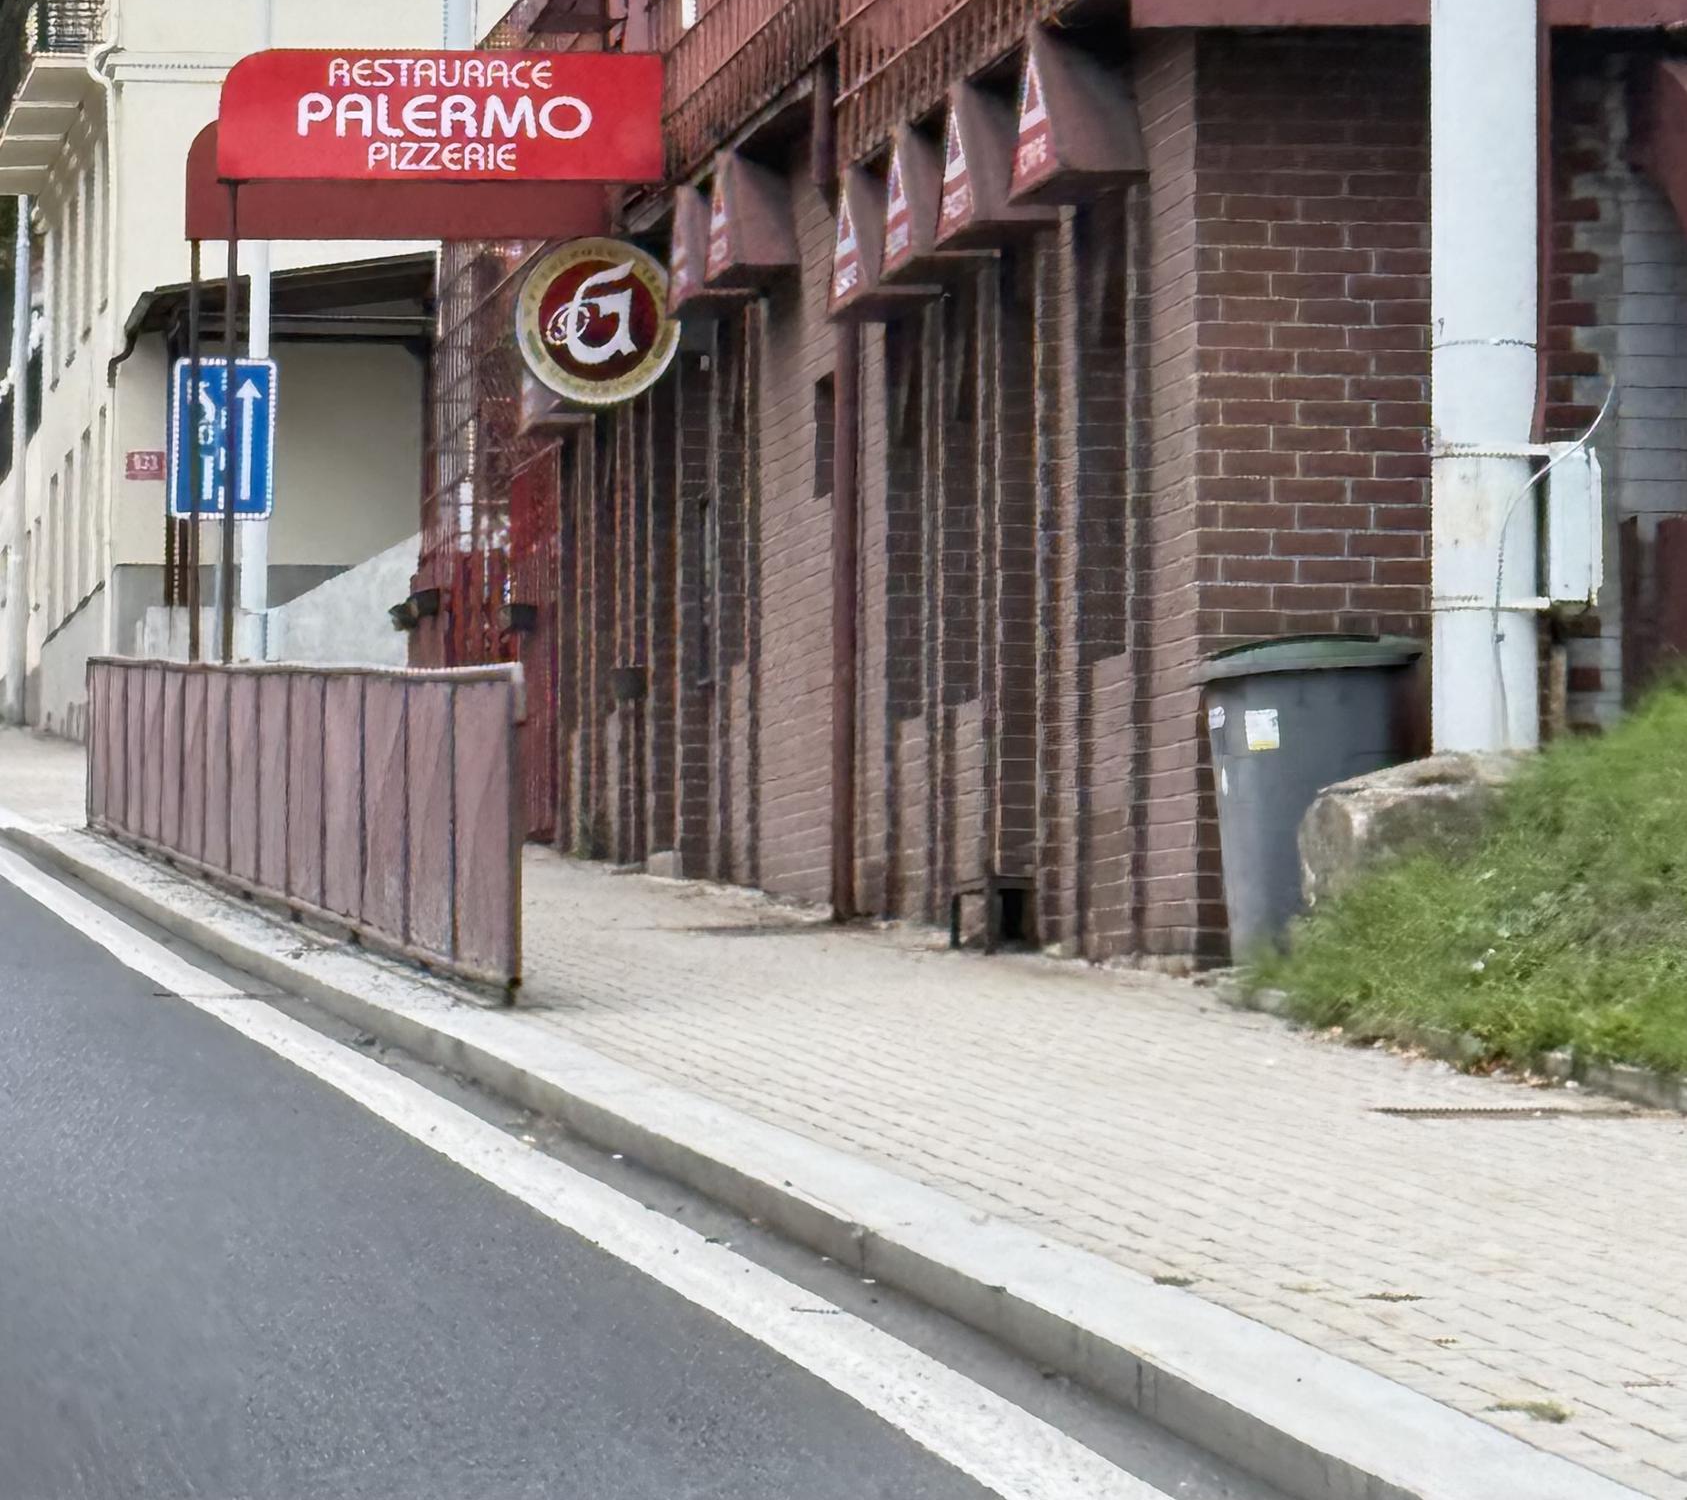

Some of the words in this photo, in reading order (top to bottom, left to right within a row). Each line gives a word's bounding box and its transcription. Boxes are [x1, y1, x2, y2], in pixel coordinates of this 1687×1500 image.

[328, 57, 553, 89] RESTAURACE
[297, 92, 592, 140] PALERMO
[367, 141, 517, 172] PIZZERIE
